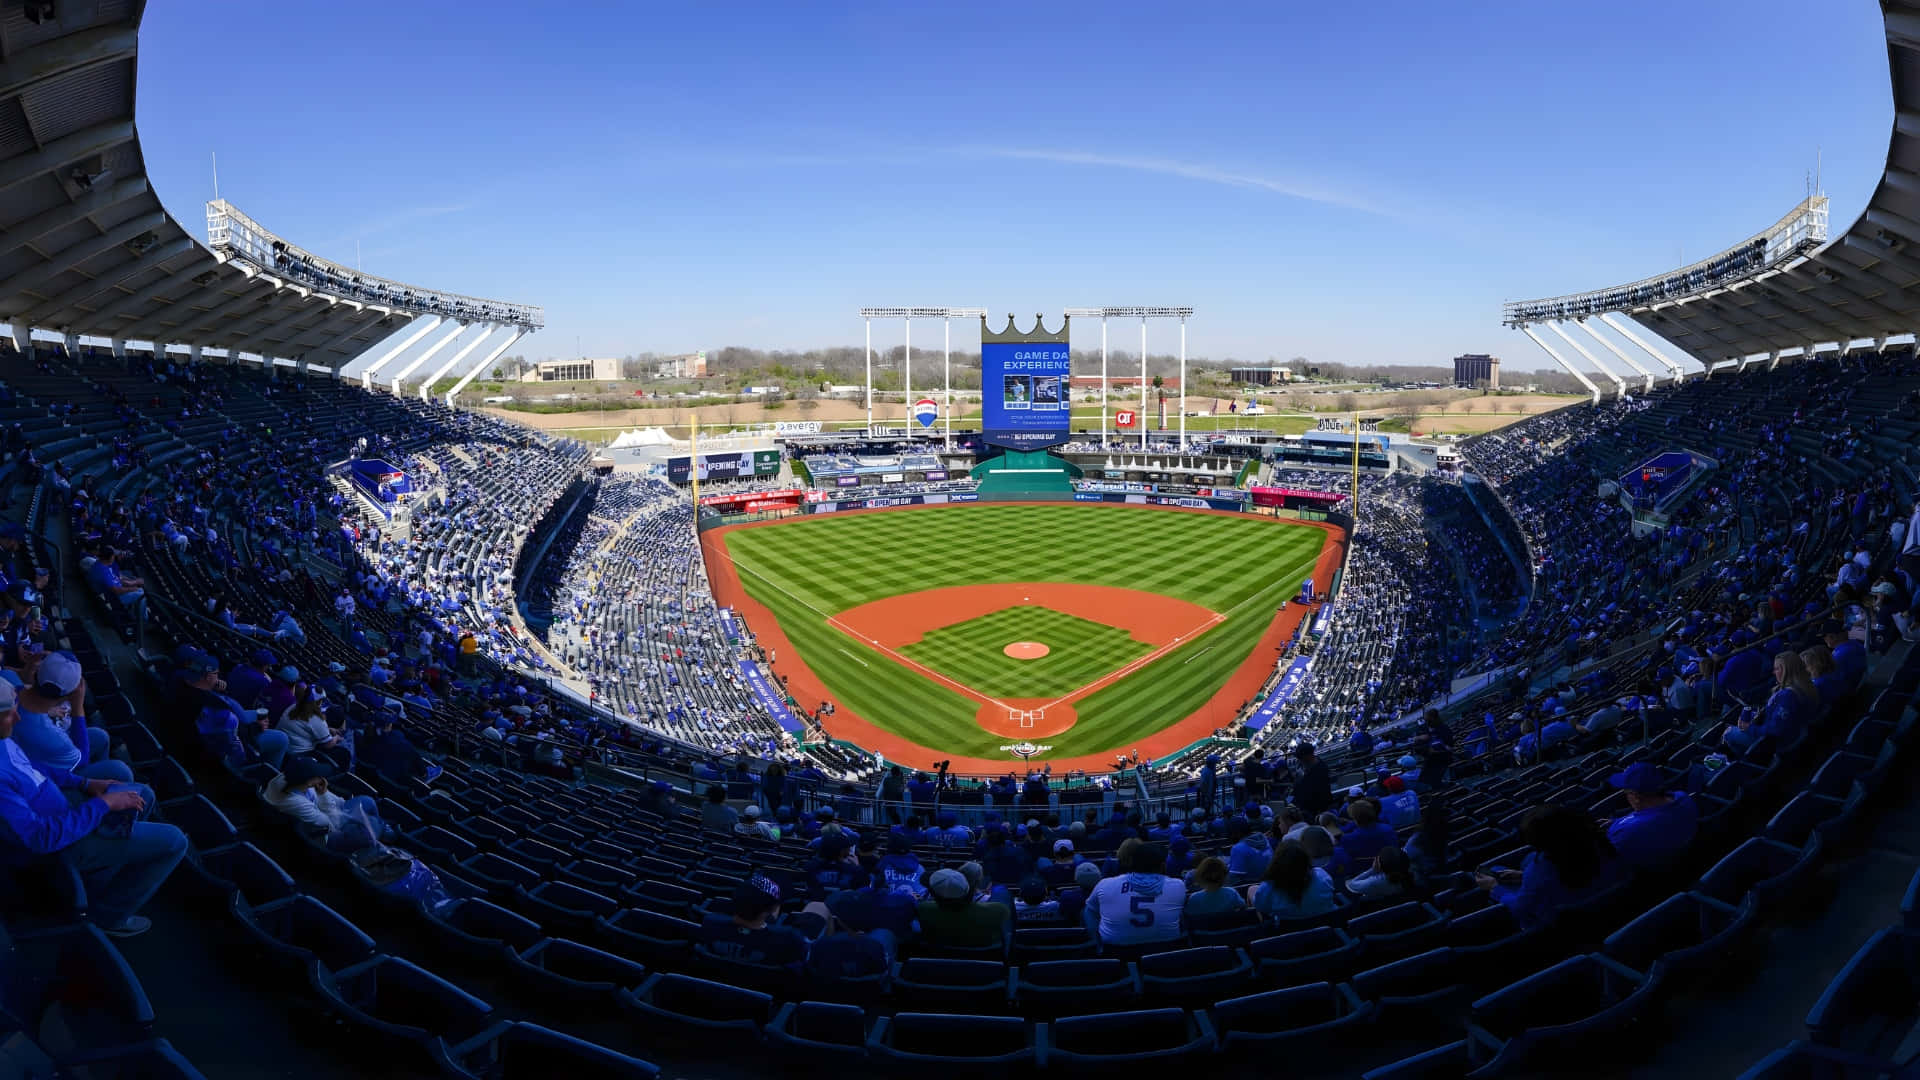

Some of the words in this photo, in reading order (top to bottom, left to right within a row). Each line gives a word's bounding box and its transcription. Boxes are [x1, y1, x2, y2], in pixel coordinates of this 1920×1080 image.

[1117, 412, 1132, 424] QT
[786, 422, 821, 433] evergy
[706, 461, 736, 471] OPENING
[737, 460, 750, 468] DAY
[874, 498, 900, 508] OPENING
[900, 498, 912, 506] DAY
[1192, 499, 1203, 507] DAY
[884, 868, 919, 883] PEREZ
[1130, 896, 1155, 928] 5
